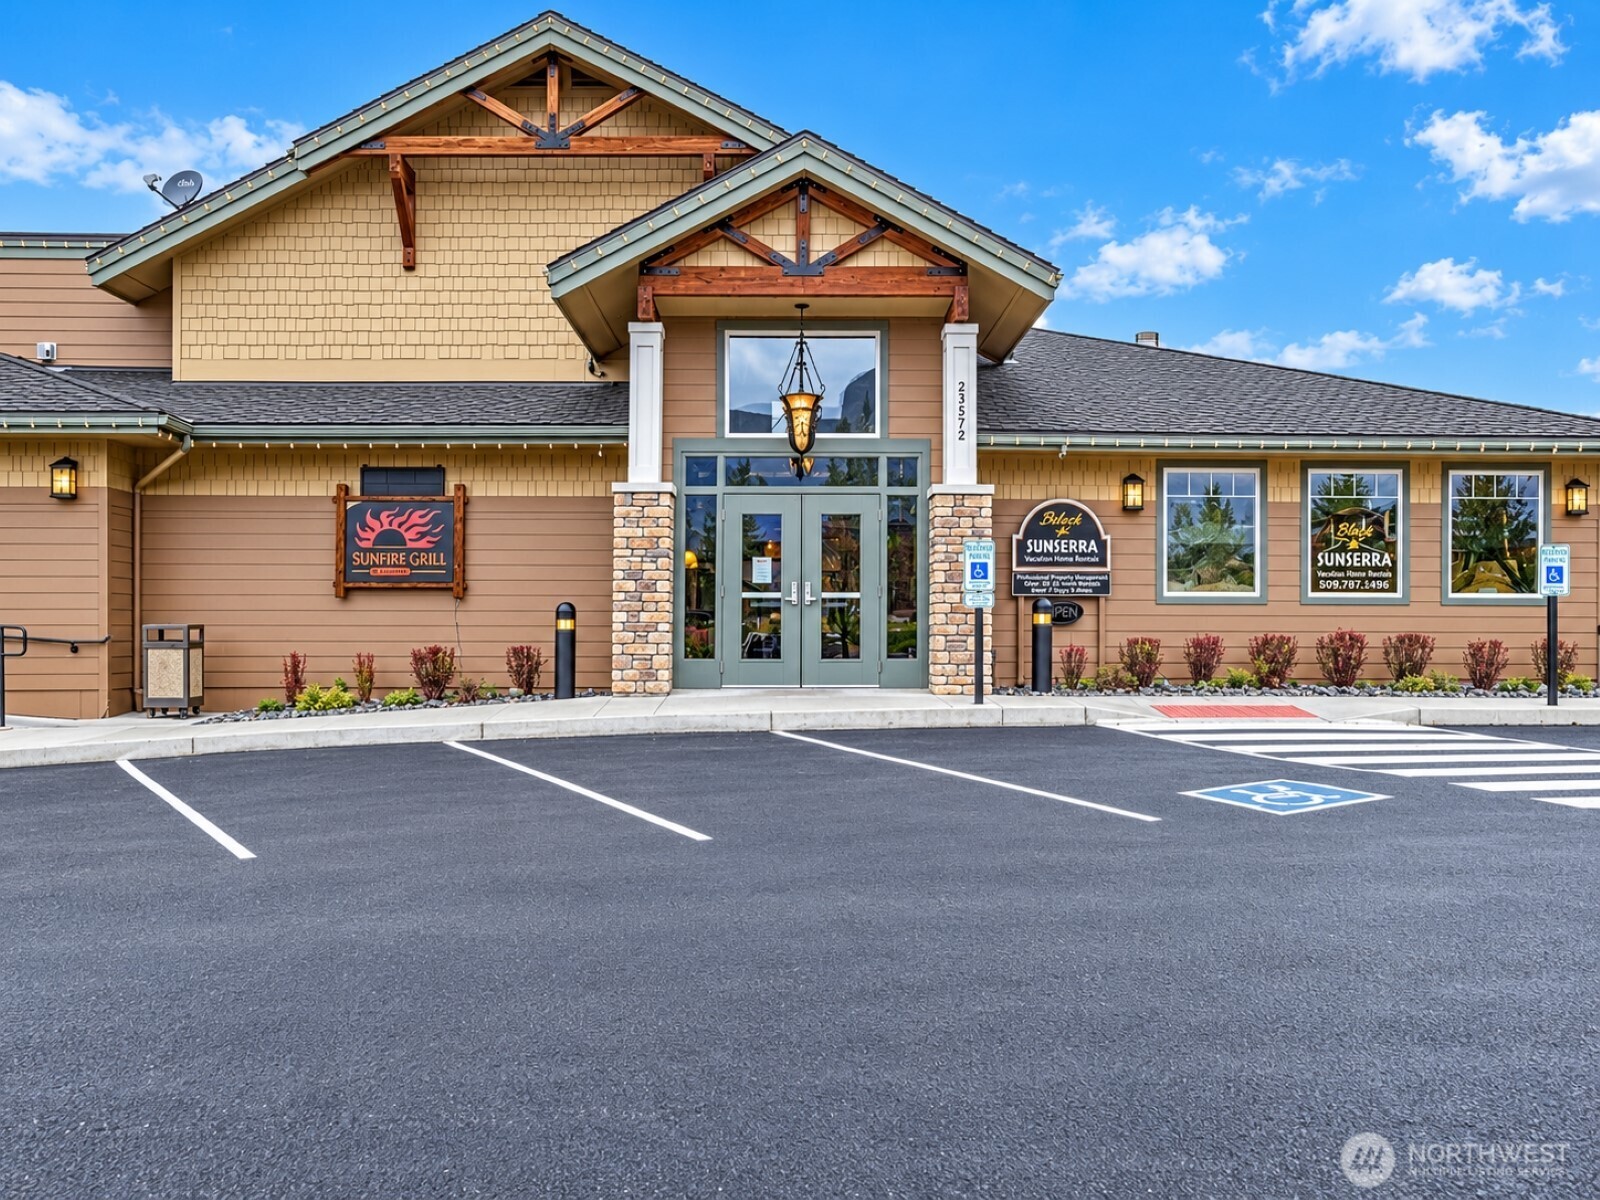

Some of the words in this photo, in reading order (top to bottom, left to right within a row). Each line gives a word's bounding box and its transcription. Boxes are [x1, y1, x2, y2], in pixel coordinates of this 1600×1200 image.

[958, 381, 966, 441] 23572
[1026, 539, 1099, 553] SUNSERRA
[352, 551, 406, 566] SUNFIRE
[409, 551, 447, 566] GRILL
[1317, 551, 1393, 567] SUNSERRA
[1052, 605, 1079, 619] PEN
